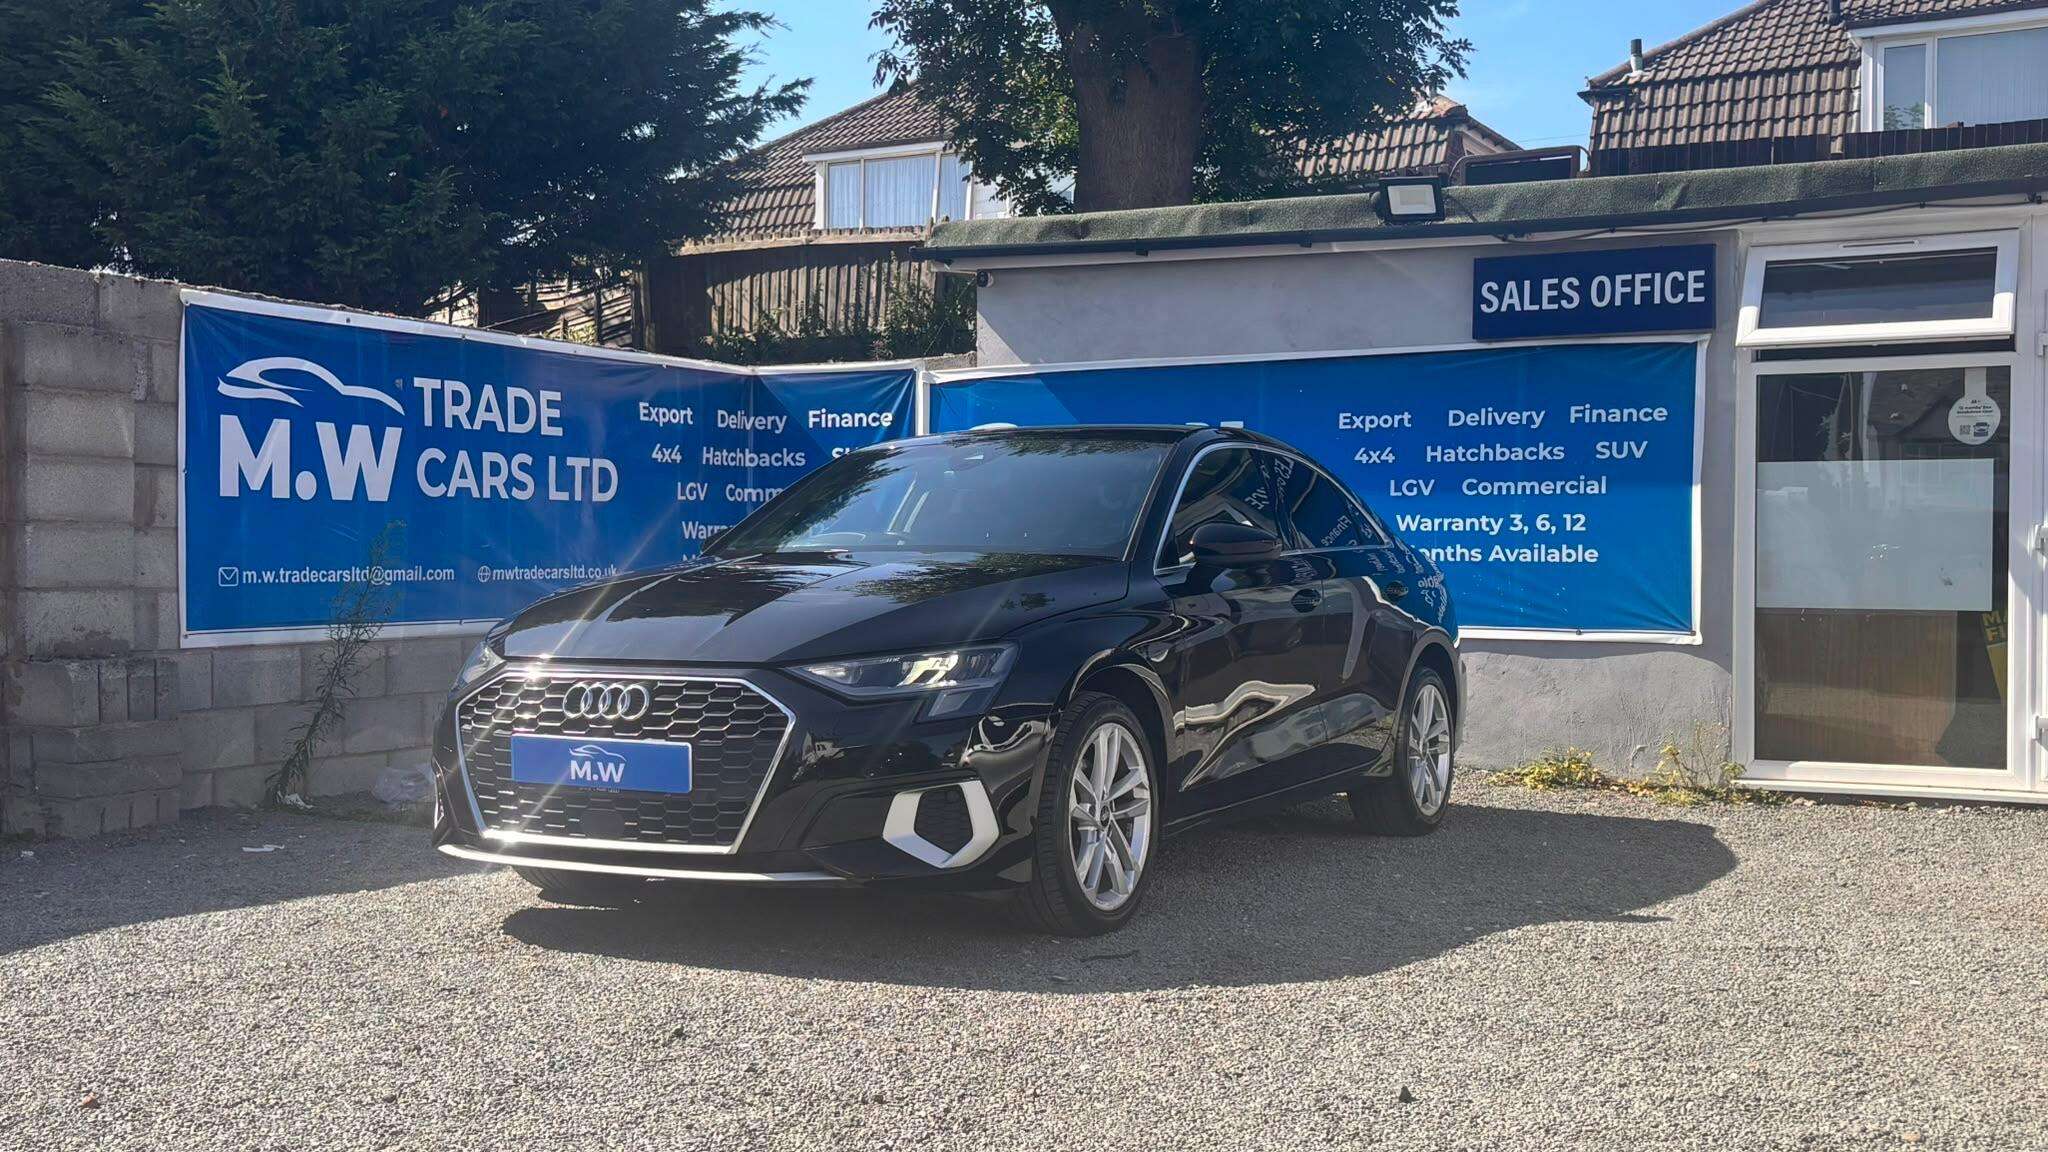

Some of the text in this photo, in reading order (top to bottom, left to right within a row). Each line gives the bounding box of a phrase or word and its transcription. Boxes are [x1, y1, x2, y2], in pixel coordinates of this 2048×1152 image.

[1480, 270, 1705, 313] SALES OFFICE
[414, 377, 563, 436] TRADE
[639, 402, 893, 433] Export Delivery Finance
[1339, 404, 1668, 432] Export Delivery Finance
[220, 415, 403, 502] M.W
[652, 444, 806, 467] 4x4 Hatchbacks
[1354, 441, 1648, 463] 4x4 Hatchbacks SUV
[417, 448, 618, 502] CARS LTD
[1390, 475, 1606, 496] LGV Commercial
[677, 482, 784, 502] LGV Comm
[682, 521, 734, 540] Warr
[1396, 515, 1503, 535] Warranty
[1510, 514, 1528, 536] 3,
[1536, 514, 1556, 536] 6,
[1563, 514, 1586, 531] 12
[1488, 544, 1598, 562] Available
[570, 760, 625, 782] M.W
